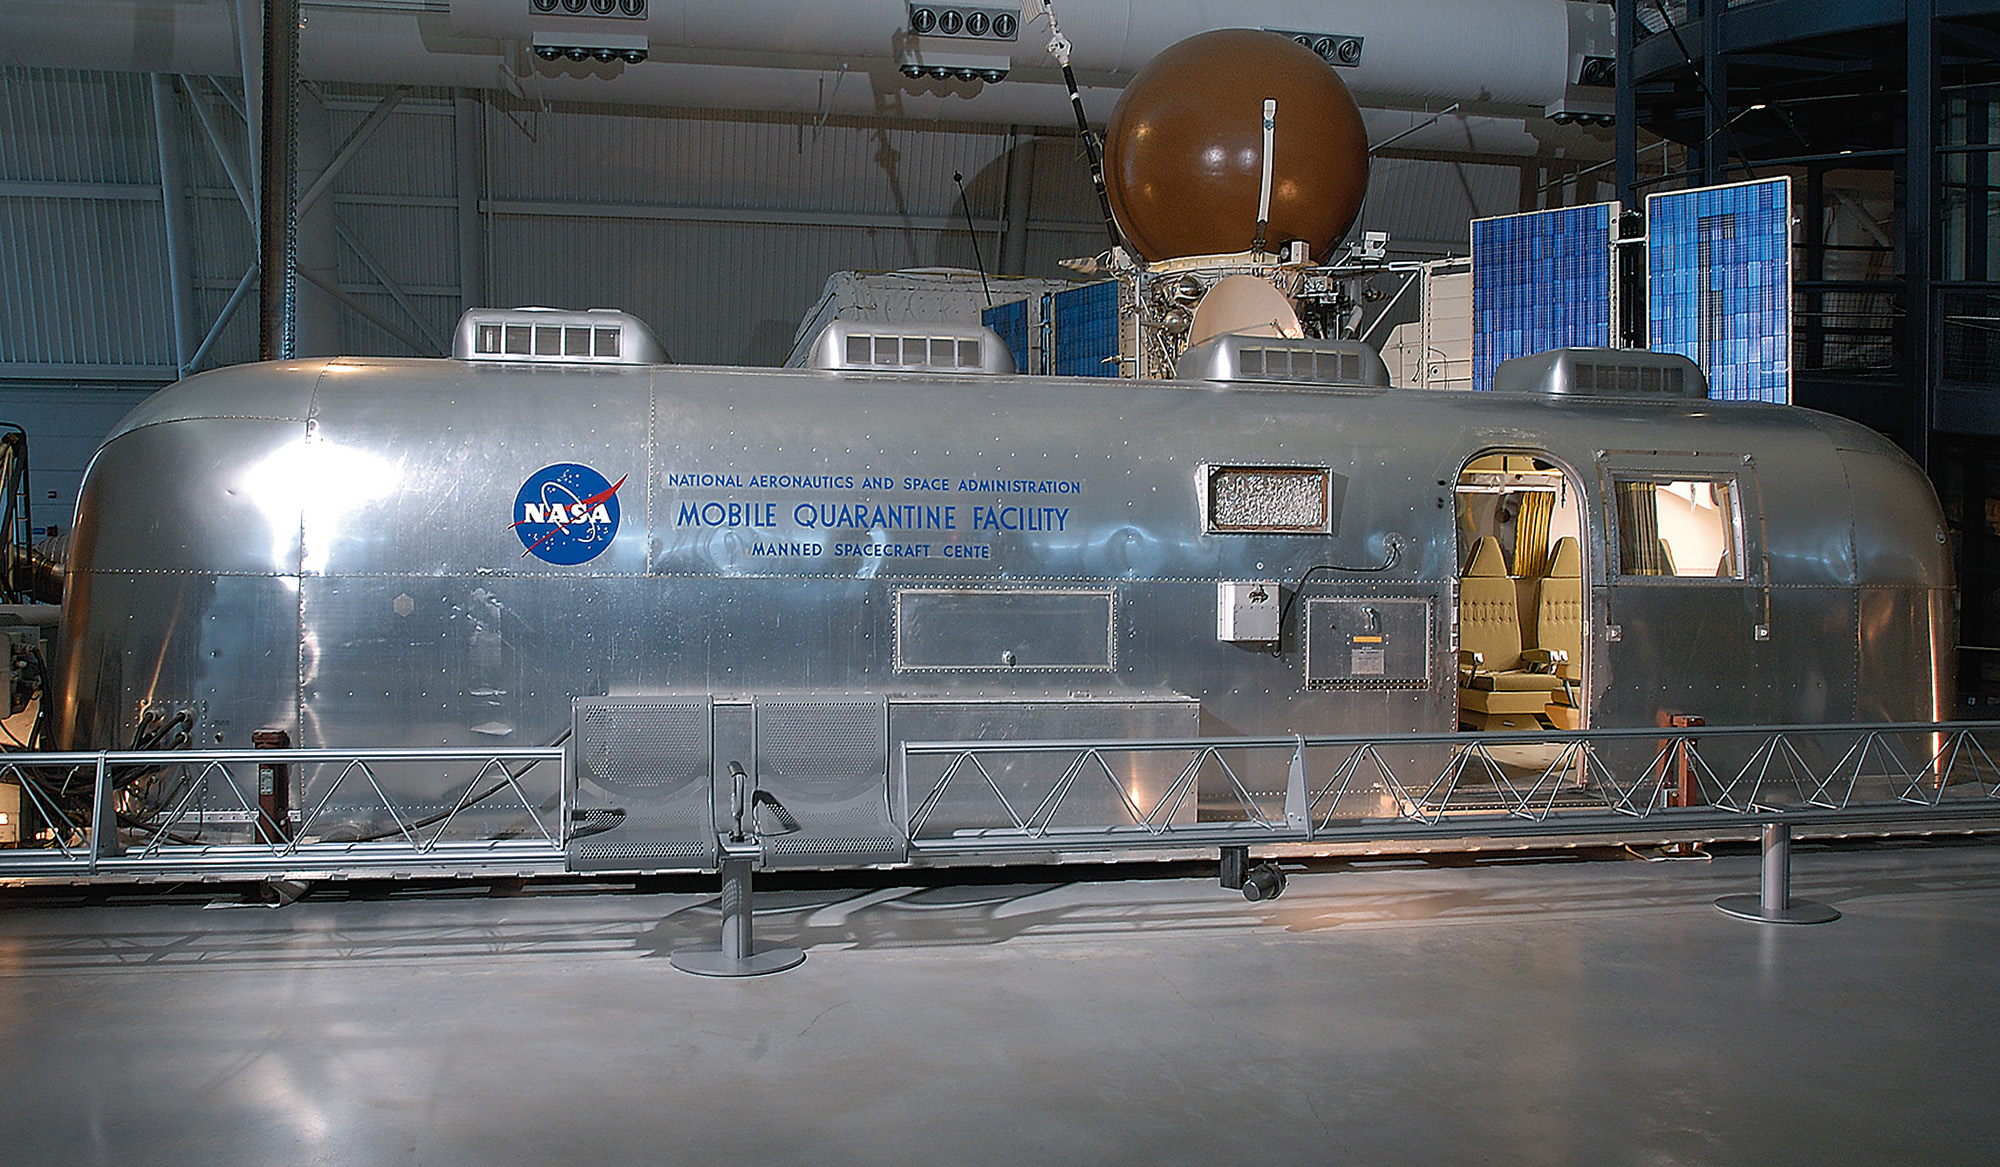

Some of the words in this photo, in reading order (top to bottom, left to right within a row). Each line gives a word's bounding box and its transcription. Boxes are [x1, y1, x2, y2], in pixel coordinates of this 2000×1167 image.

[668, 473, 743, 488] NATIONAL
[749, 475, 854, 489] AERONAUTICS
[861, 477, 894, 490] AND
[903, 477, 950, 492] SPACE
[958, 479, 1081, 494] ADMINISTRATION
[523, 502, 612, 524] NASA
[676, 501, 777, 527] MOBILE
[793, 502, 956, 530] QUARANTINE
[972, 506, 1070, 532] FACILITY
[752, 542, 823, 557] MANNED
[834, 543, 930, 558] SPACECRAFT
